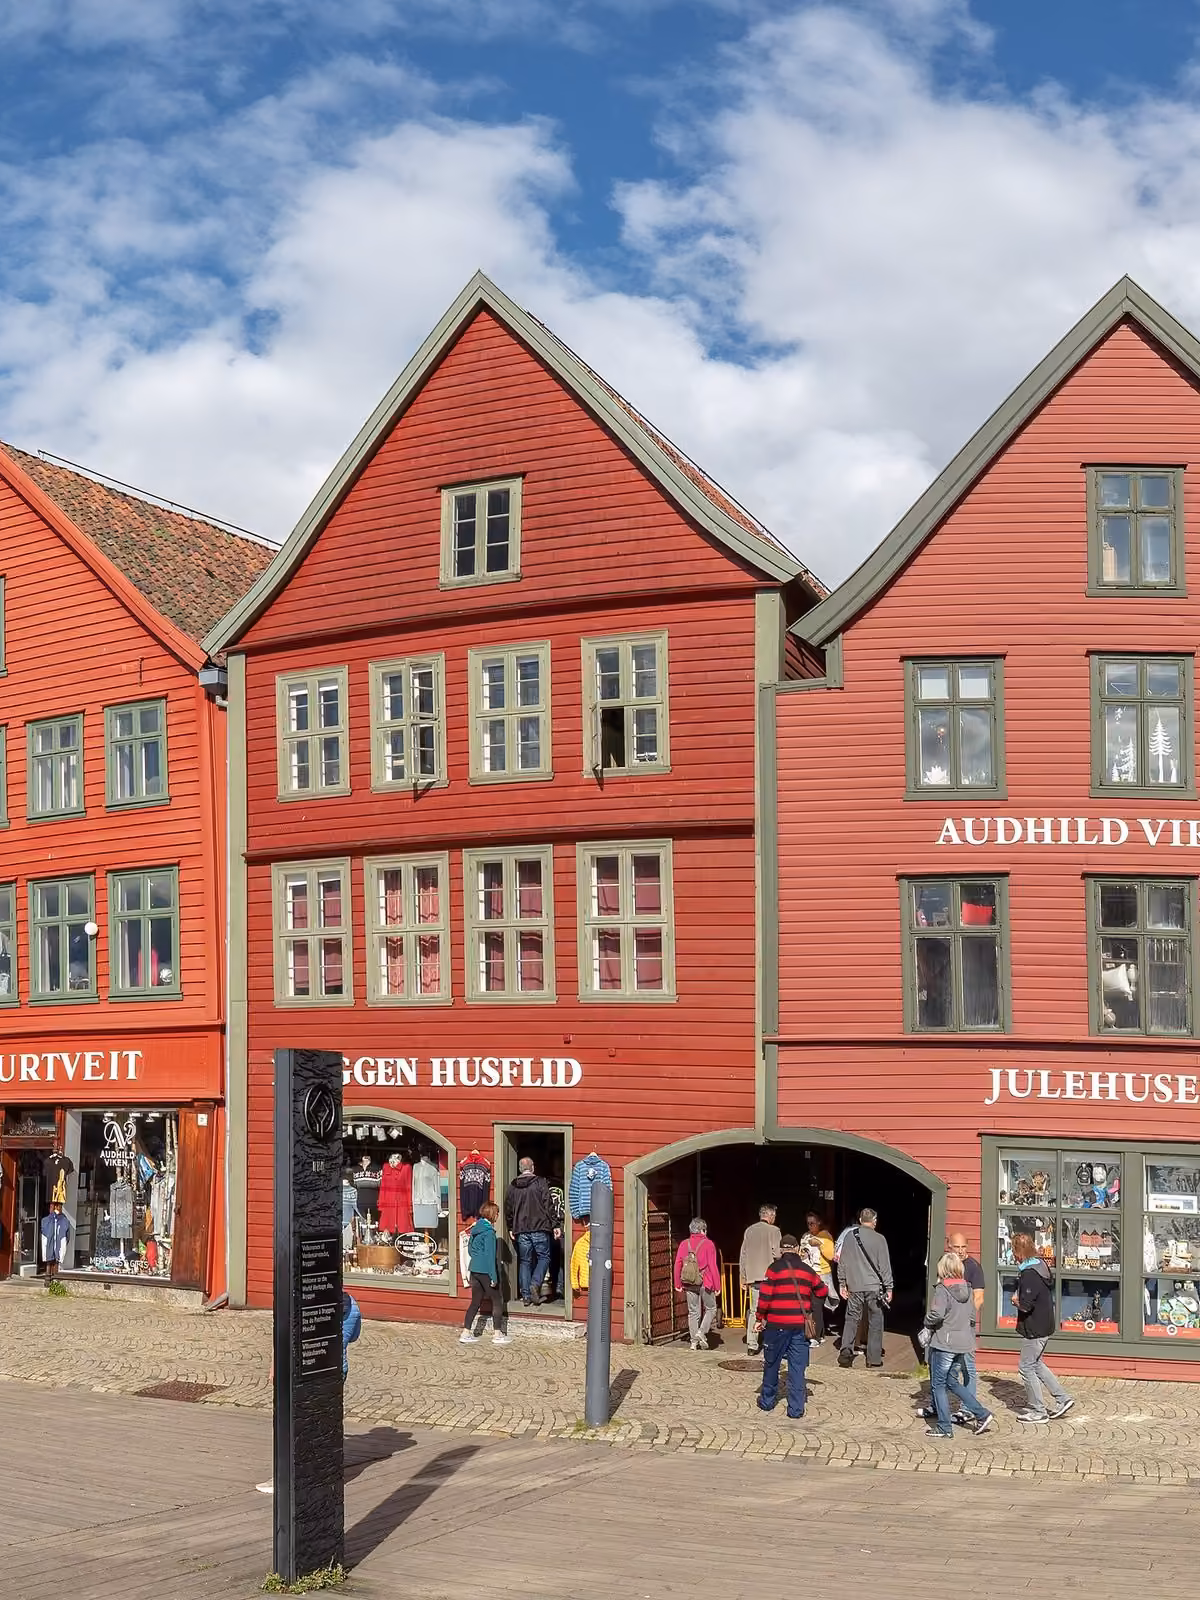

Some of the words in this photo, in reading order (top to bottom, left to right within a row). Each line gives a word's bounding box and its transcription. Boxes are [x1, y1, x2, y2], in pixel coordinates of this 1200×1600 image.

[935, 817, 1129, 846] AUDHILD
[430, 1056, 583, 1088] HUSFLID
[984, 1067, 1199, 1105] JULEHUSE
[100, 1151, 134, 1159] AUDHILD
